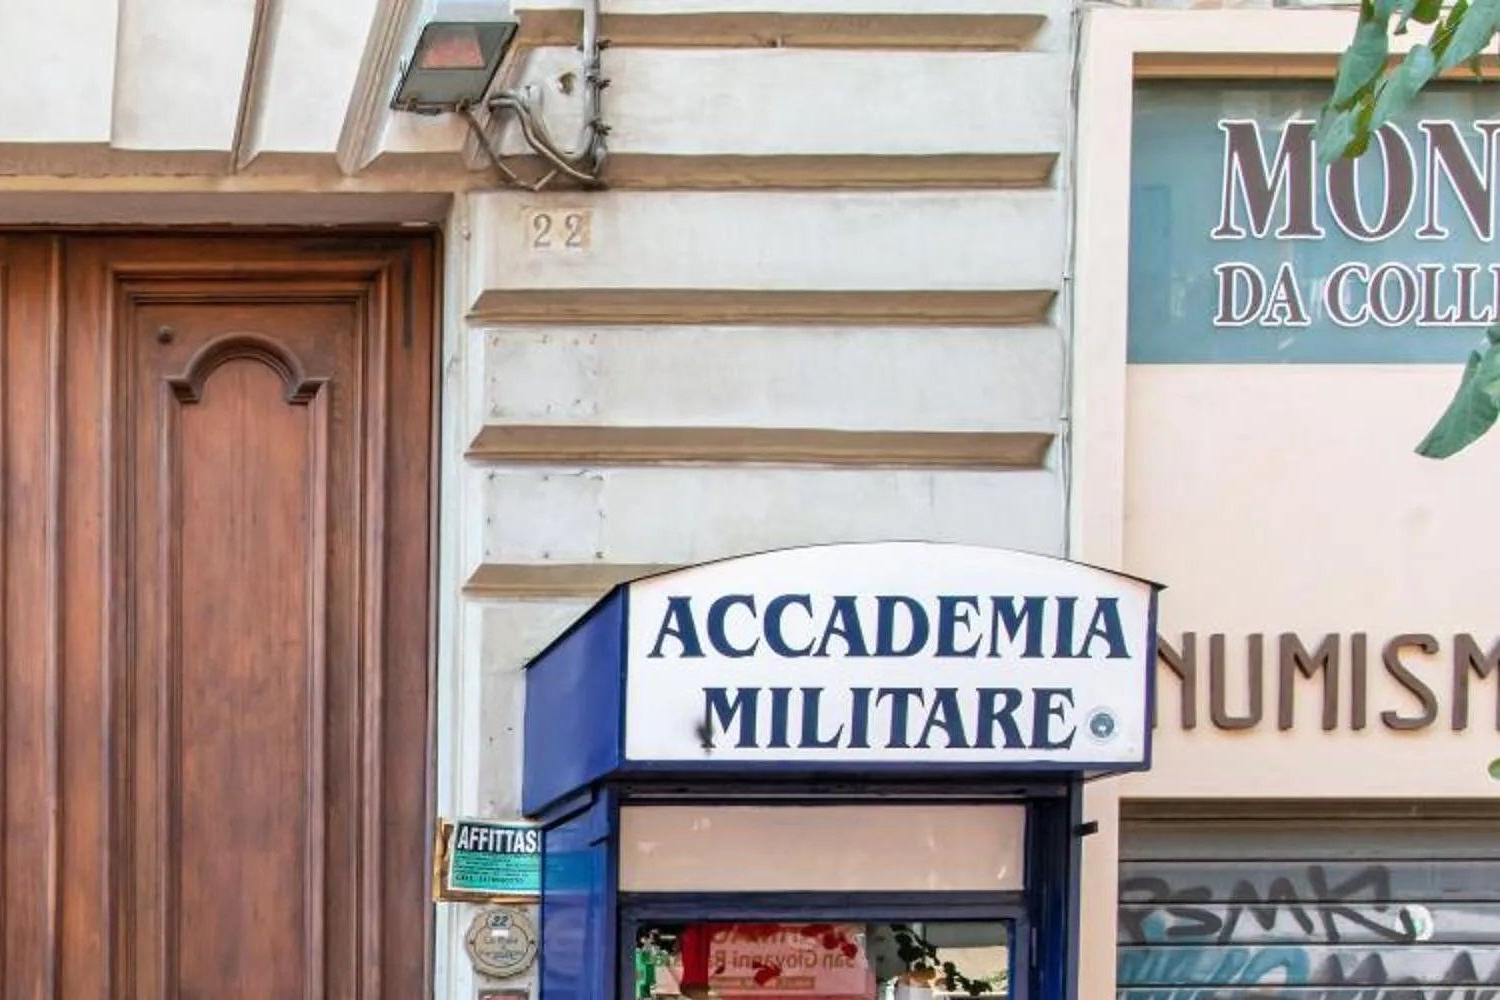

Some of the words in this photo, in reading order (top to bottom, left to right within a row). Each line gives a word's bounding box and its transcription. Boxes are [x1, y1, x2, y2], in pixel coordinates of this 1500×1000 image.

[533, 213, 582, 248] 22
[1213, 262, 1311, 327] DA
[646, 593, 1132, 659] ACCADEMIA
[701, 687, 1077, 751] MILITARE
[491, 915, 509, 927] 22
